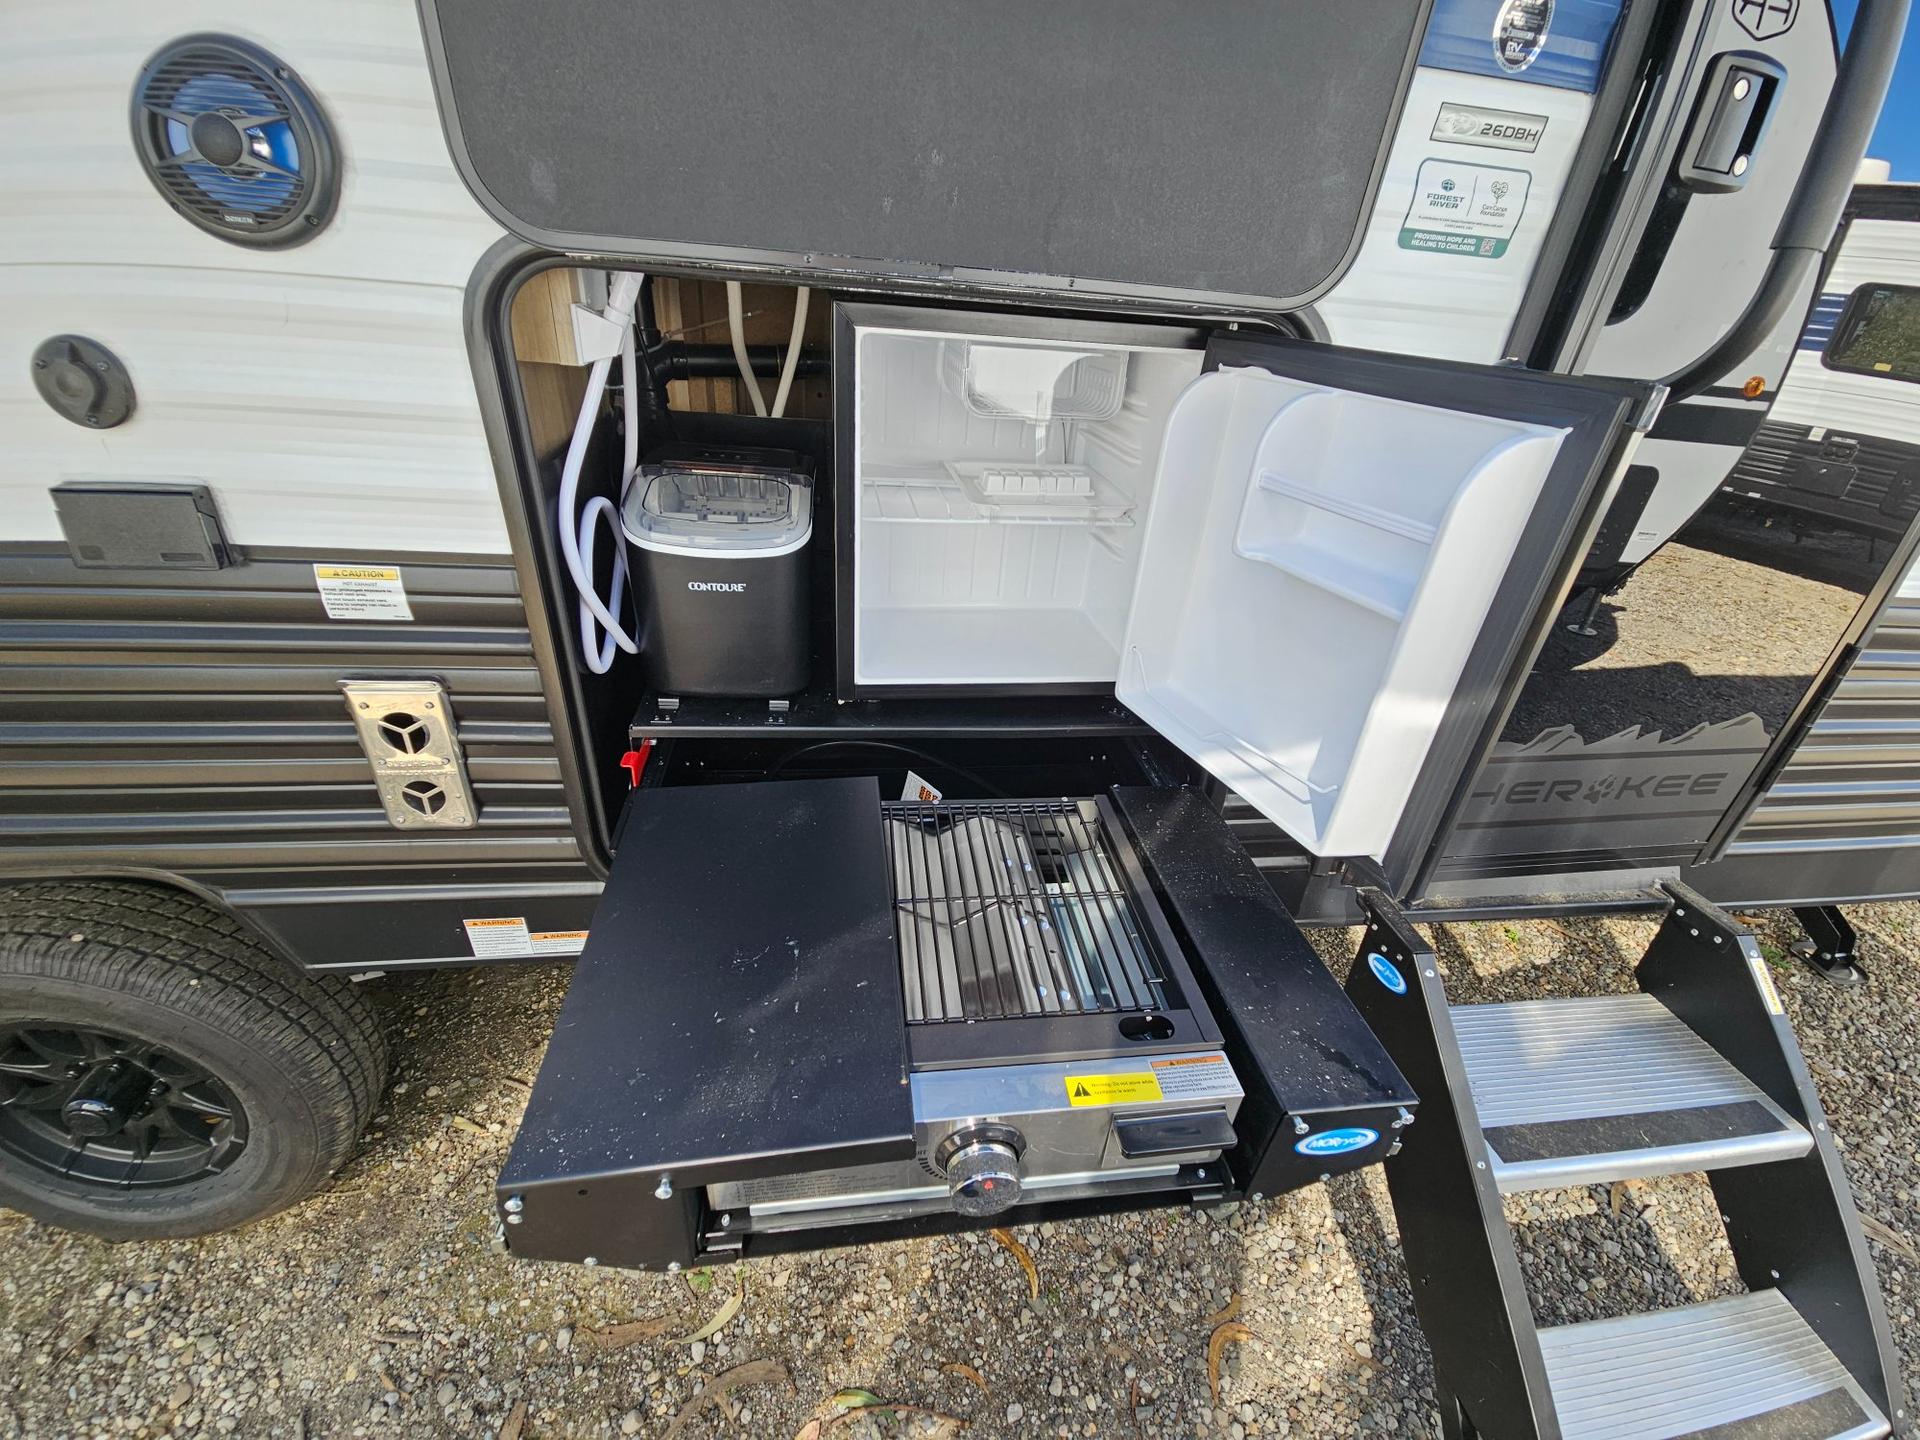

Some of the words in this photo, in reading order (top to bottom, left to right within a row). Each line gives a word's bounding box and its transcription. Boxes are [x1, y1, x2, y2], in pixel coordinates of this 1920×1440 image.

[1480, 123, 1539, 141] 26DBH
[1427, 193, 1464, 203] FOREST
[1429, 200, 1459, 209] RIVER
[1414, 232, 1446, 241] PROVIDING
[1446, 235, 1463, 243] HOPE
[1463, 237, 1477, 245] AND
[1411, 239, 1437, 248] HEALING
[1437, 241, 1446, 249] TO
[1446, 243, 1475, 252] CHILDREN
[341, 569, 384, 578] CAUTION
